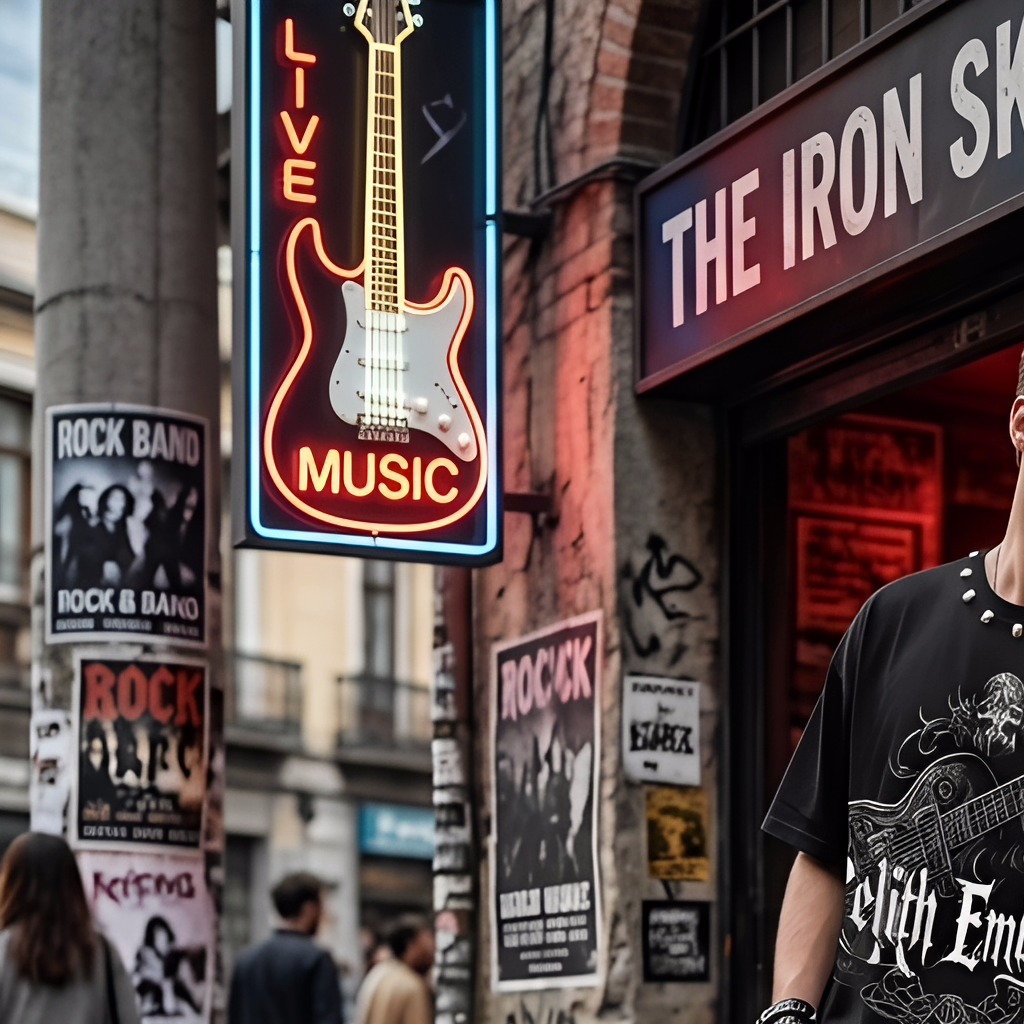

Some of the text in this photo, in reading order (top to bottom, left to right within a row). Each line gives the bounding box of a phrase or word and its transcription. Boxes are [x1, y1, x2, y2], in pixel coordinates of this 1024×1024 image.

[279, 18, 320, 204] LIVE
[662, 168, 762, 329] THE
[783, 72, 924, 271] IRON
[57, 417, 200, 468] ROCK BAND
[298, 446, 459, 504] MUSIC
[83, 663, 204, 728] ROCK
